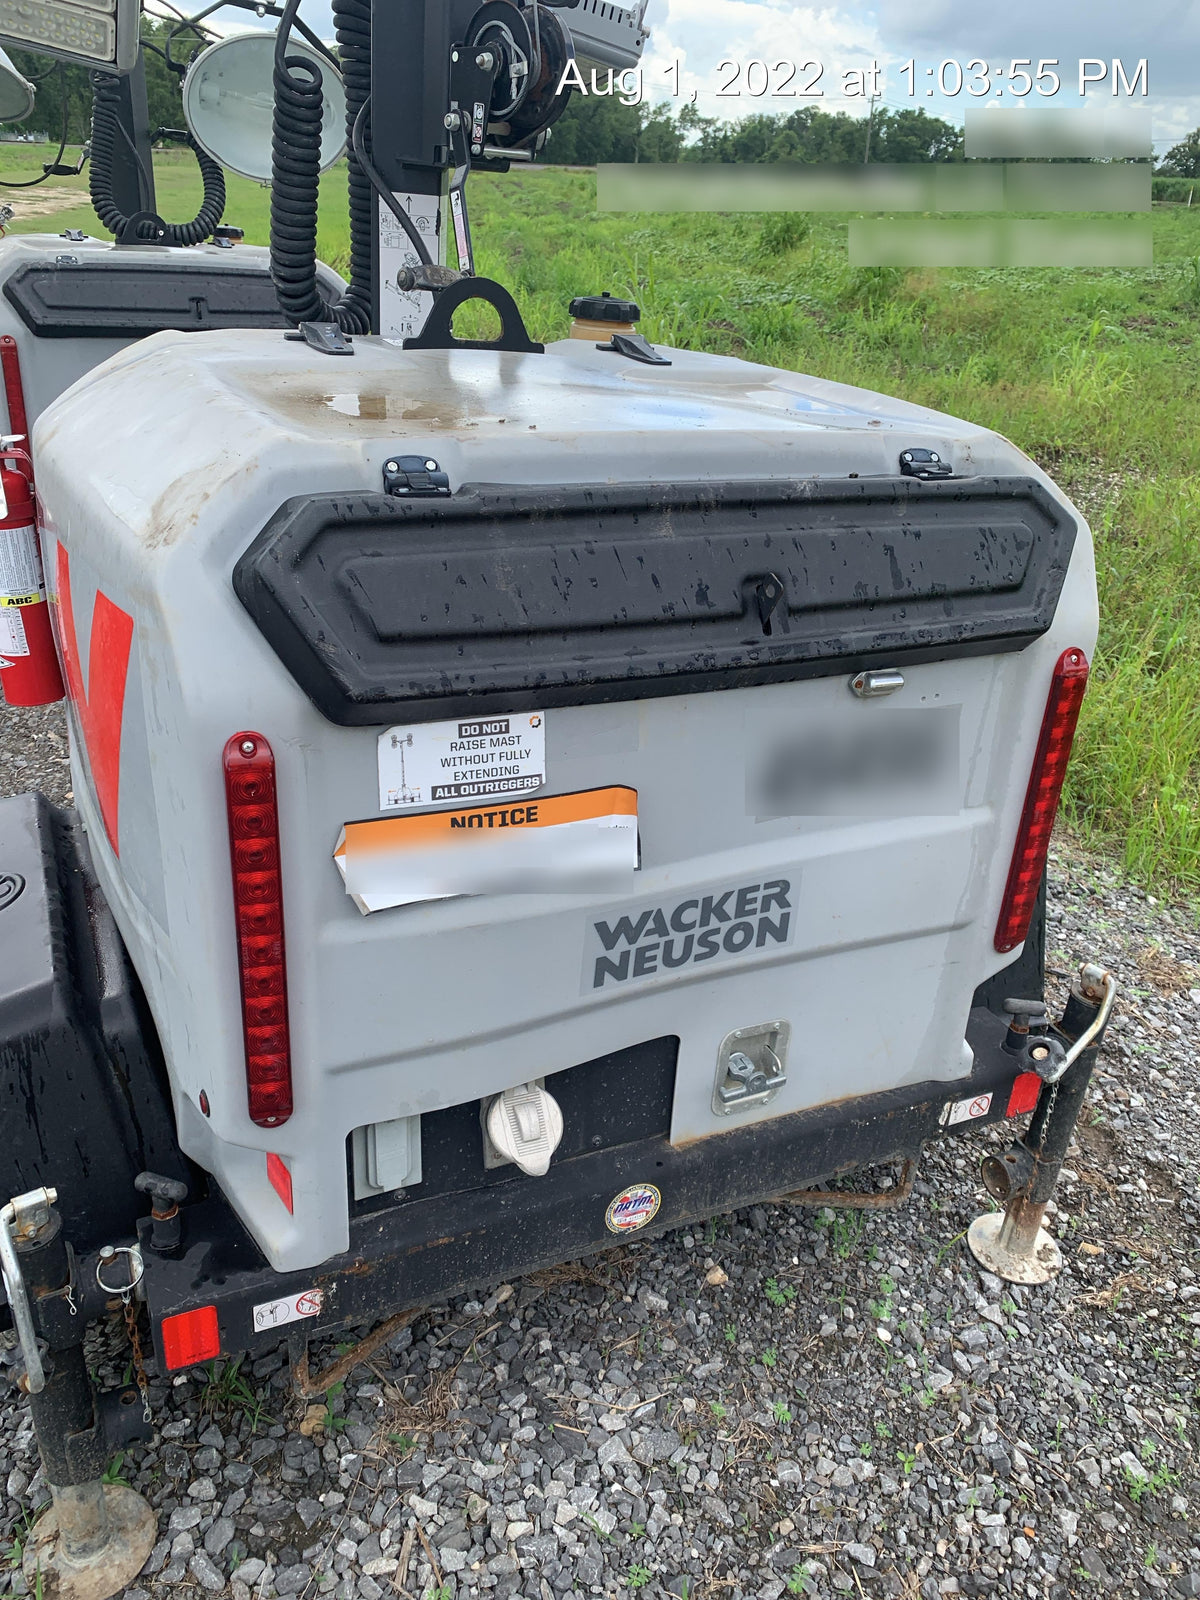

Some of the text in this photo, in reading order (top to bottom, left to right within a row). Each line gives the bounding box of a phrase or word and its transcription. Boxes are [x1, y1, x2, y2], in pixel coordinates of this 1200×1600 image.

[7, 596, 33, 606] ABC
[461, 721, 508, 736] DO NOT
[450, 735, 522, 752] RAISE MAST
[440, 749, 531, 768] WITHOUT FULLY
[453, 765, 520, 781] EXTENDING
[435, 776, 540, 798] ALL OUTRIGGERS
[450, 805, 538, 828] NOTICE
[593, 879, 792, 951] WACKER
[593, 911, 791, 989] NEUSON
